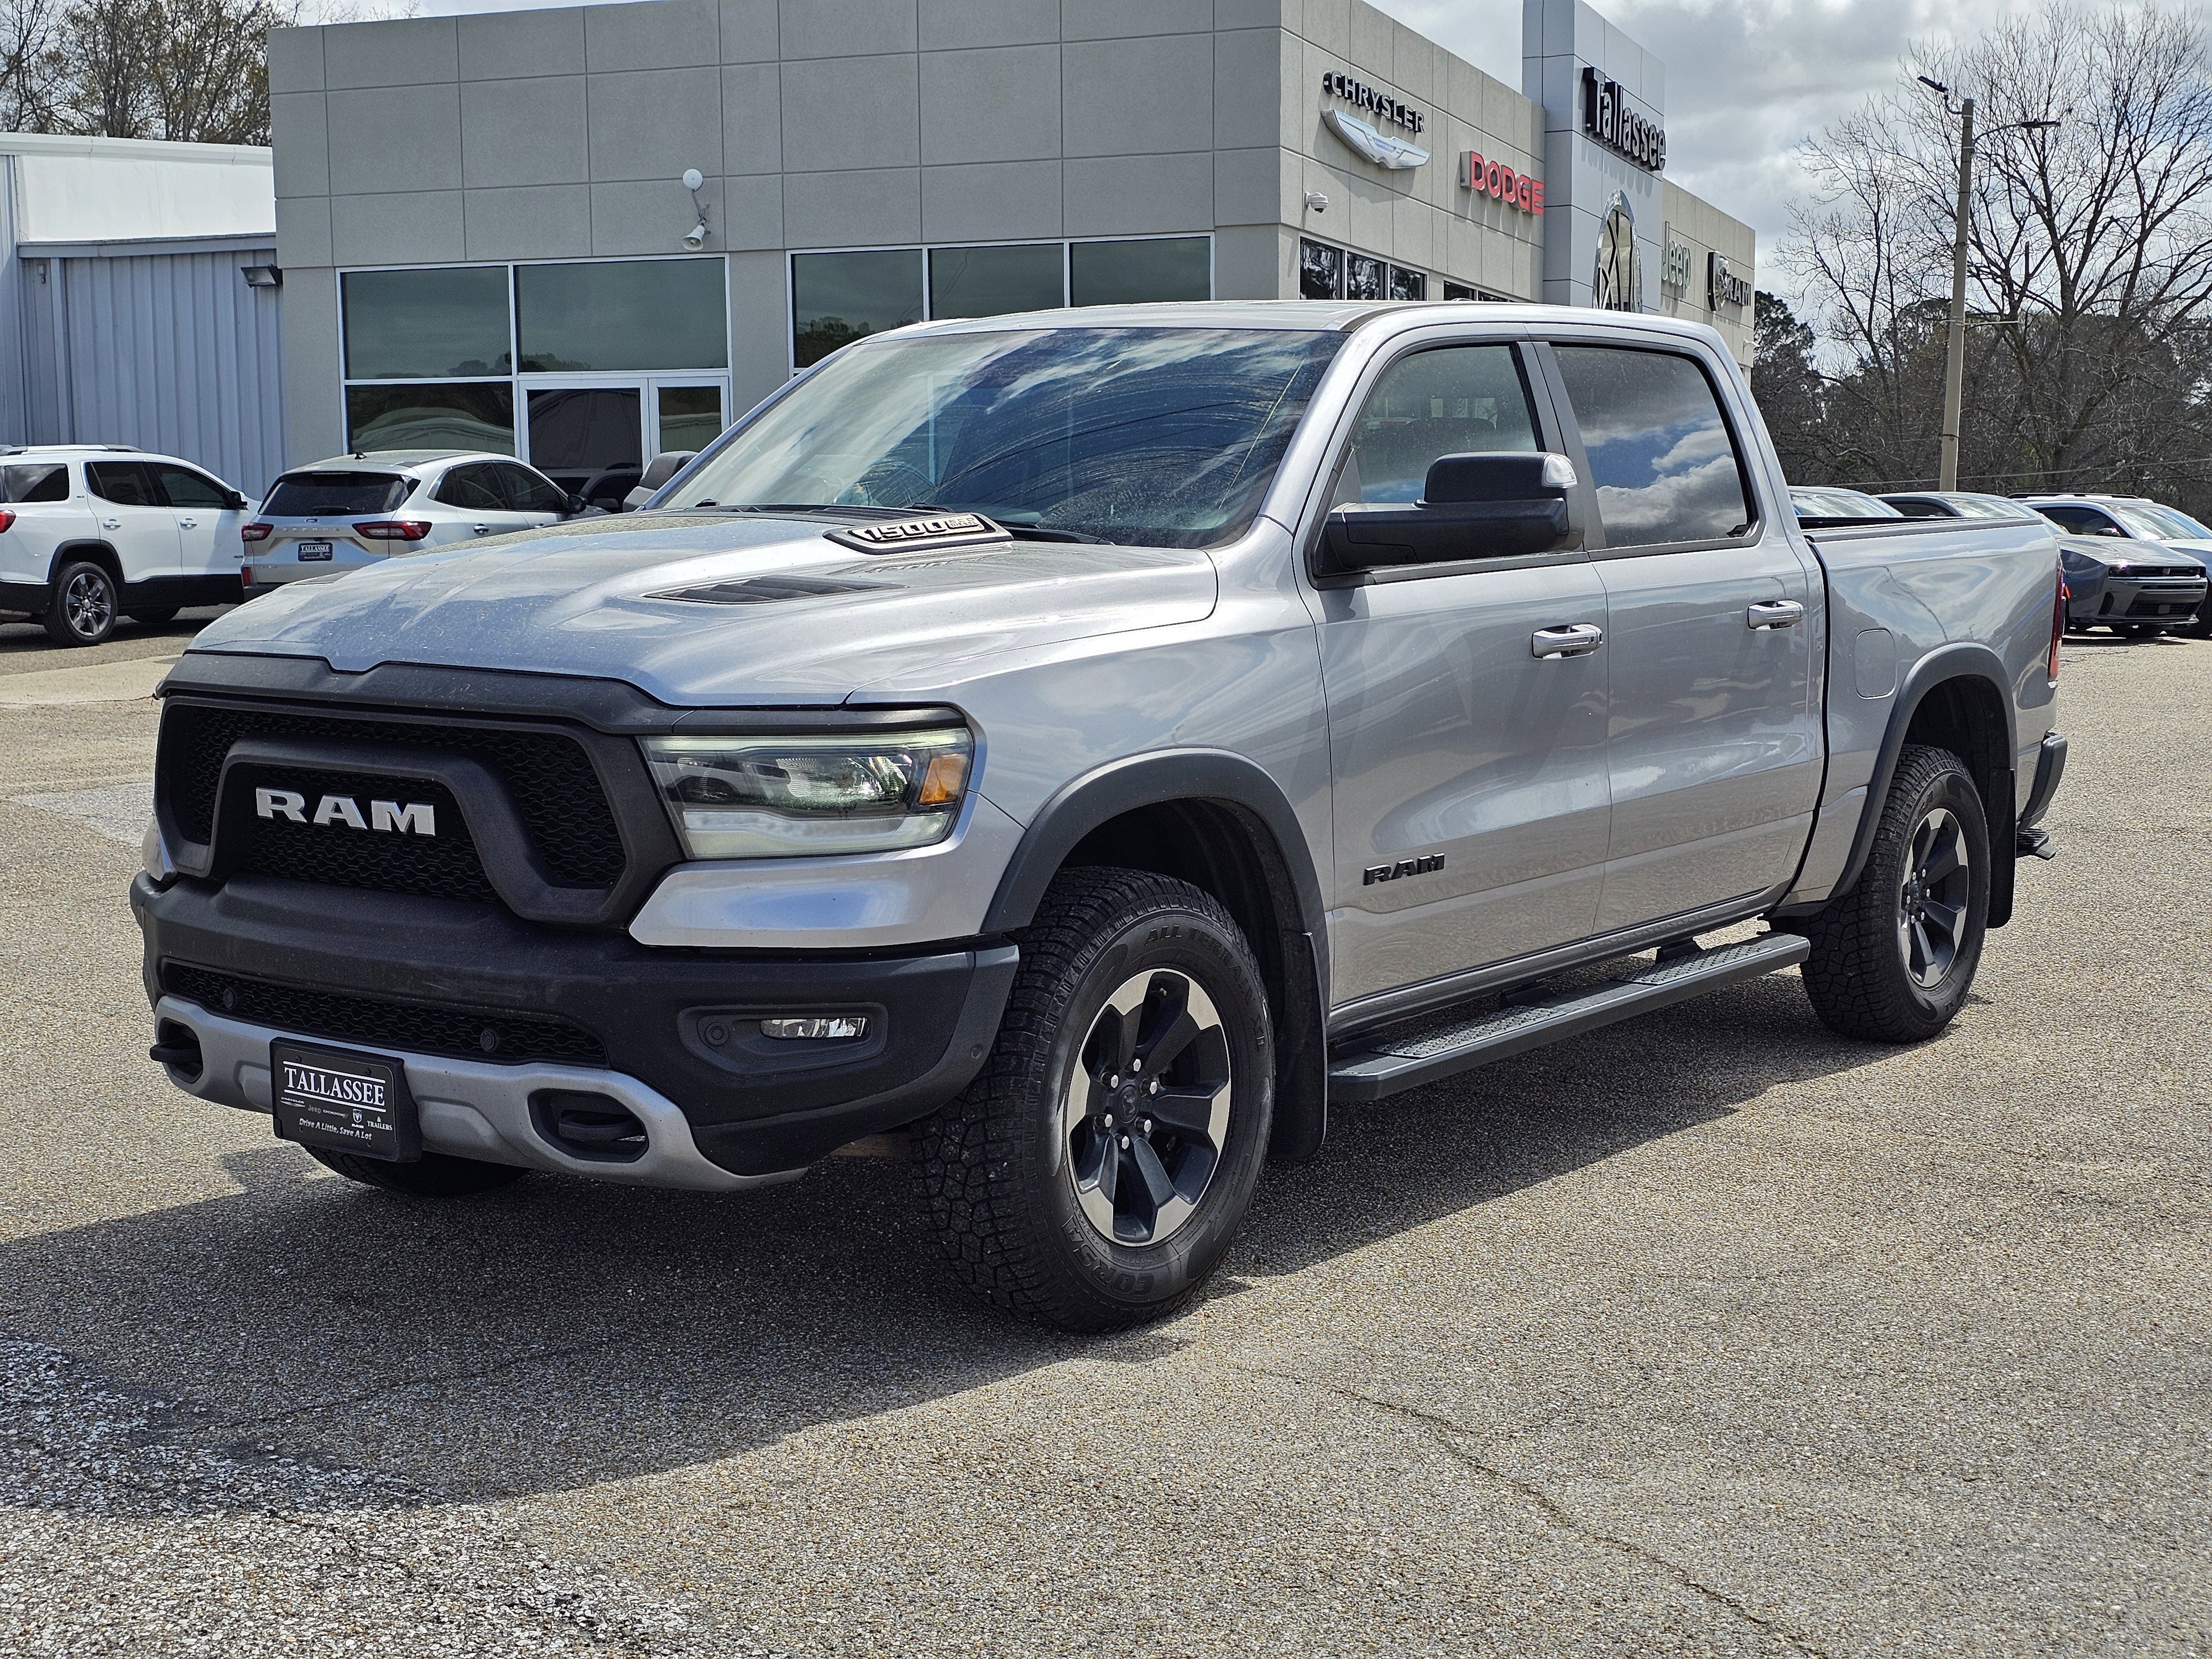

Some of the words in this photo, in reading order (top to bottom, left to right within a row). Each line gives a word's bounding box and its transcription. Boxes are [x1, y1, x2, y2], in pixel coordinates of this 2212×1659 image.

[1325, 70, 1425, 133] CHRYSLER
[1584, 67, 1666, 171] Tallassee
[1468, 150, 1545, 215] DODGE
[1661, 221, 1691, 299] Jeep
[1726, 273, 1751, 306] RAM
[864, 519, 947, 541] 1500
[255, 787, 436, 836] RAM
[1363, 852, 1445, 886] RAM
[1145, 925, 1182, 947] ALL
[284, 1067, 385, 1107] TALLASSEE
[308, 1104, 321, 1114] Jeep
[366, 1120, 393, 1131] TRAILERS
[299, 1118, 315, 1128] Drive
[321, 1122, 339, 1134] Little,
[339, 1126, 354, 1136] Save
[354, 1130, 361, 1138] A
[361, 1131, 372, 1140] Lot
[1061, 1215, 1154, 1296] CORSA
